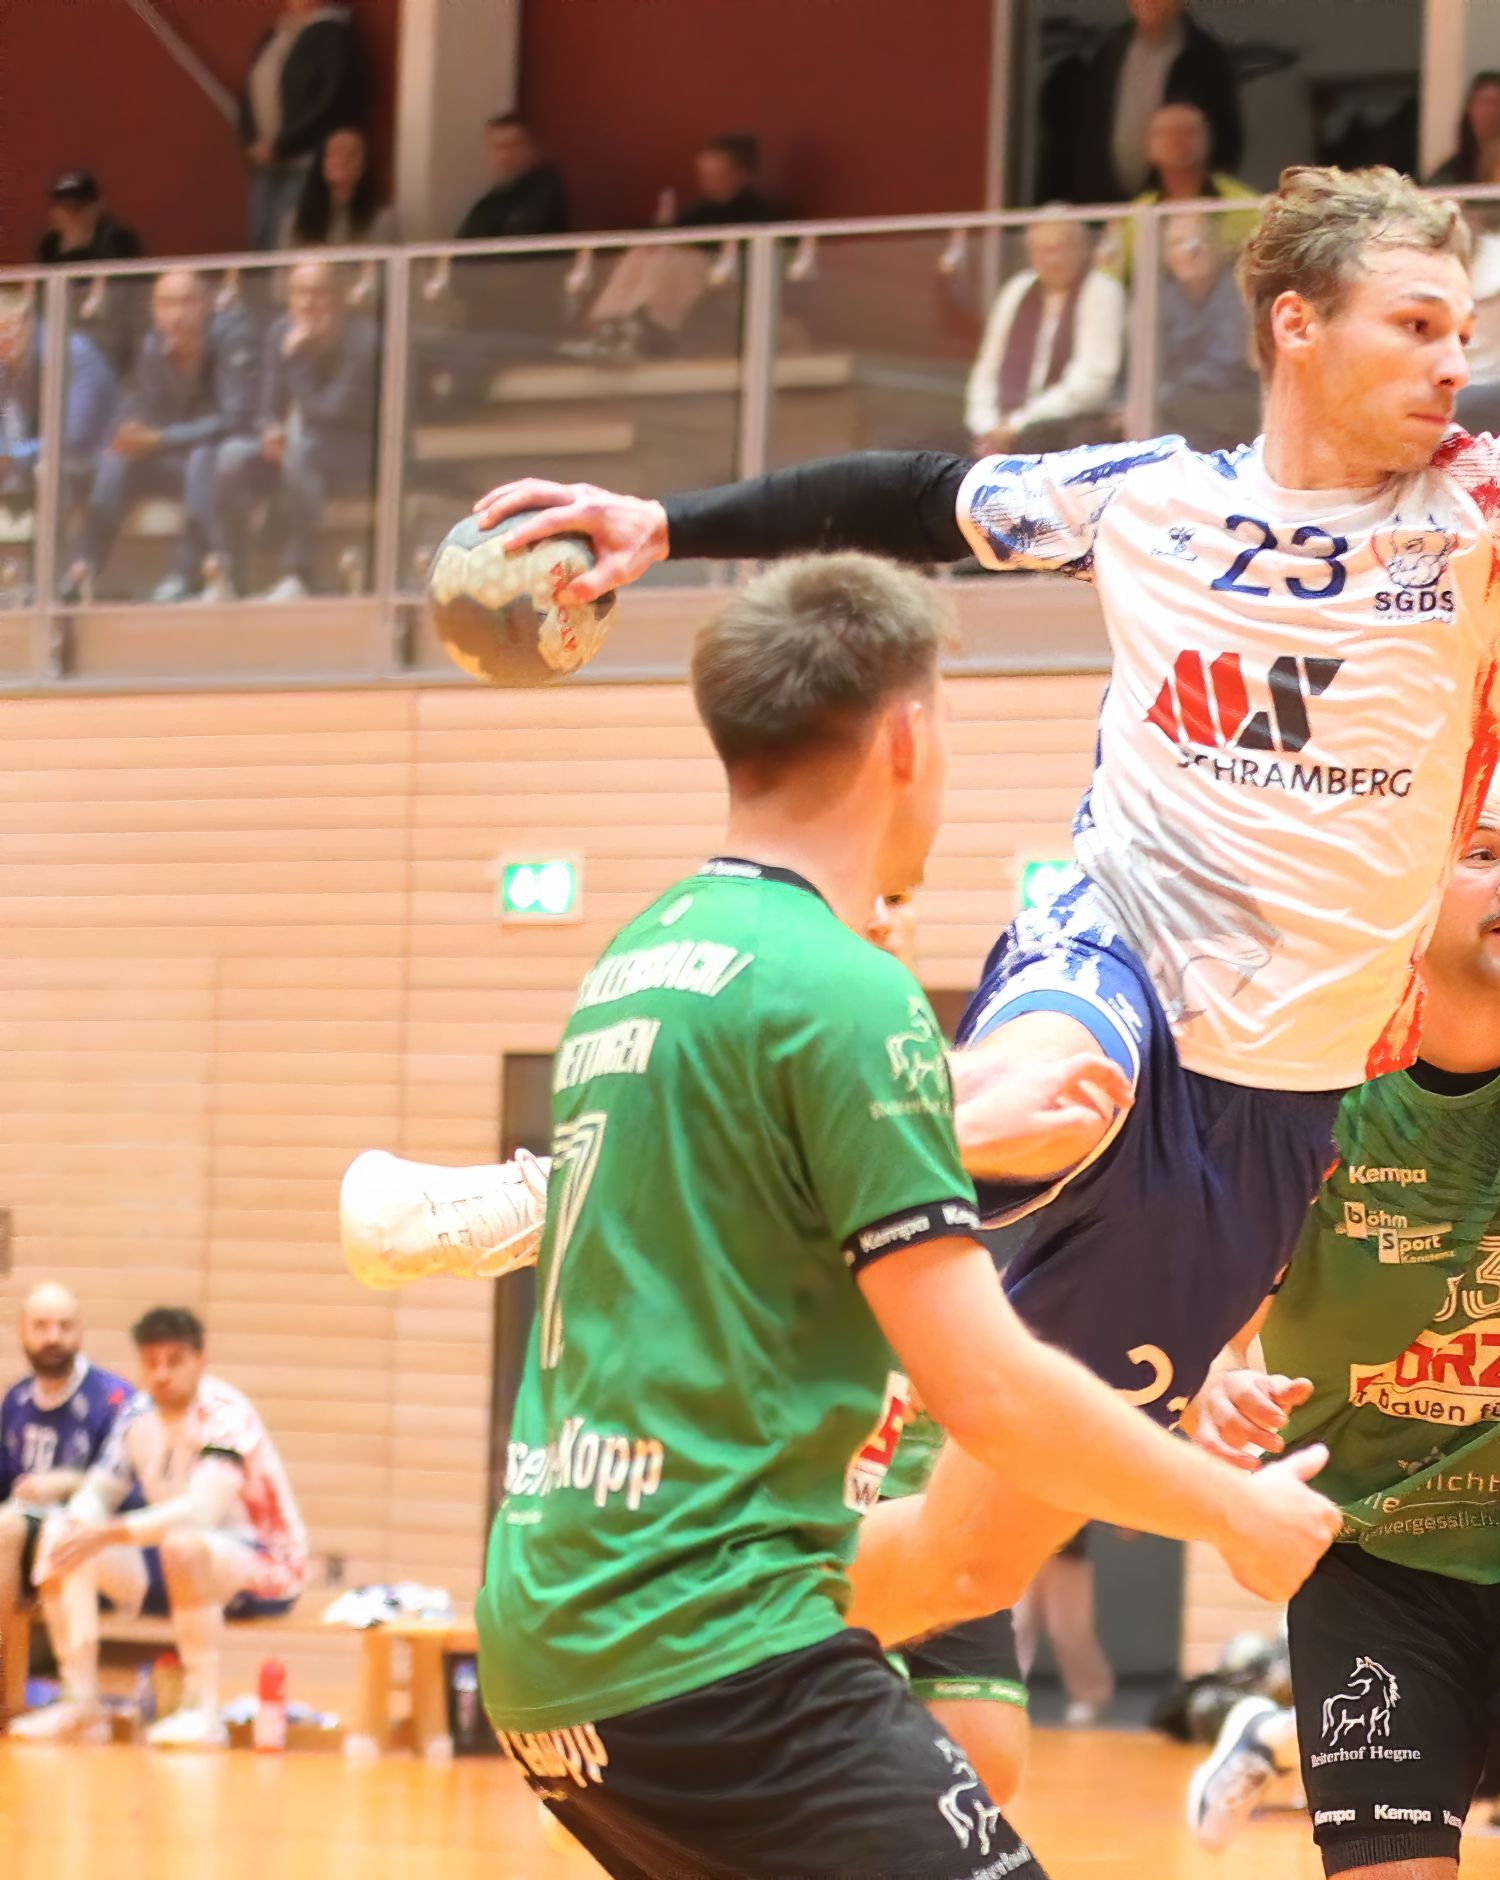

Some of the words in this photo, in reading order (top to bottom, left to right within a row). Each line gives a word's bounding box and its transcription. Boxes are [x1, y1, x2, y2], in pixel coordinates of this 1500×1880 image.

[1210, 513, 1350, 600] 23
[1374, 590, 1455, 612] SGDS
[1349, 1165, 1427, 1188] Kempa
[1378, 1388, 1466, 1422] bauen
[1369, 1745, 1421, 1762] Hegne
[1374, 1804, 1432, 1825] Kempa
